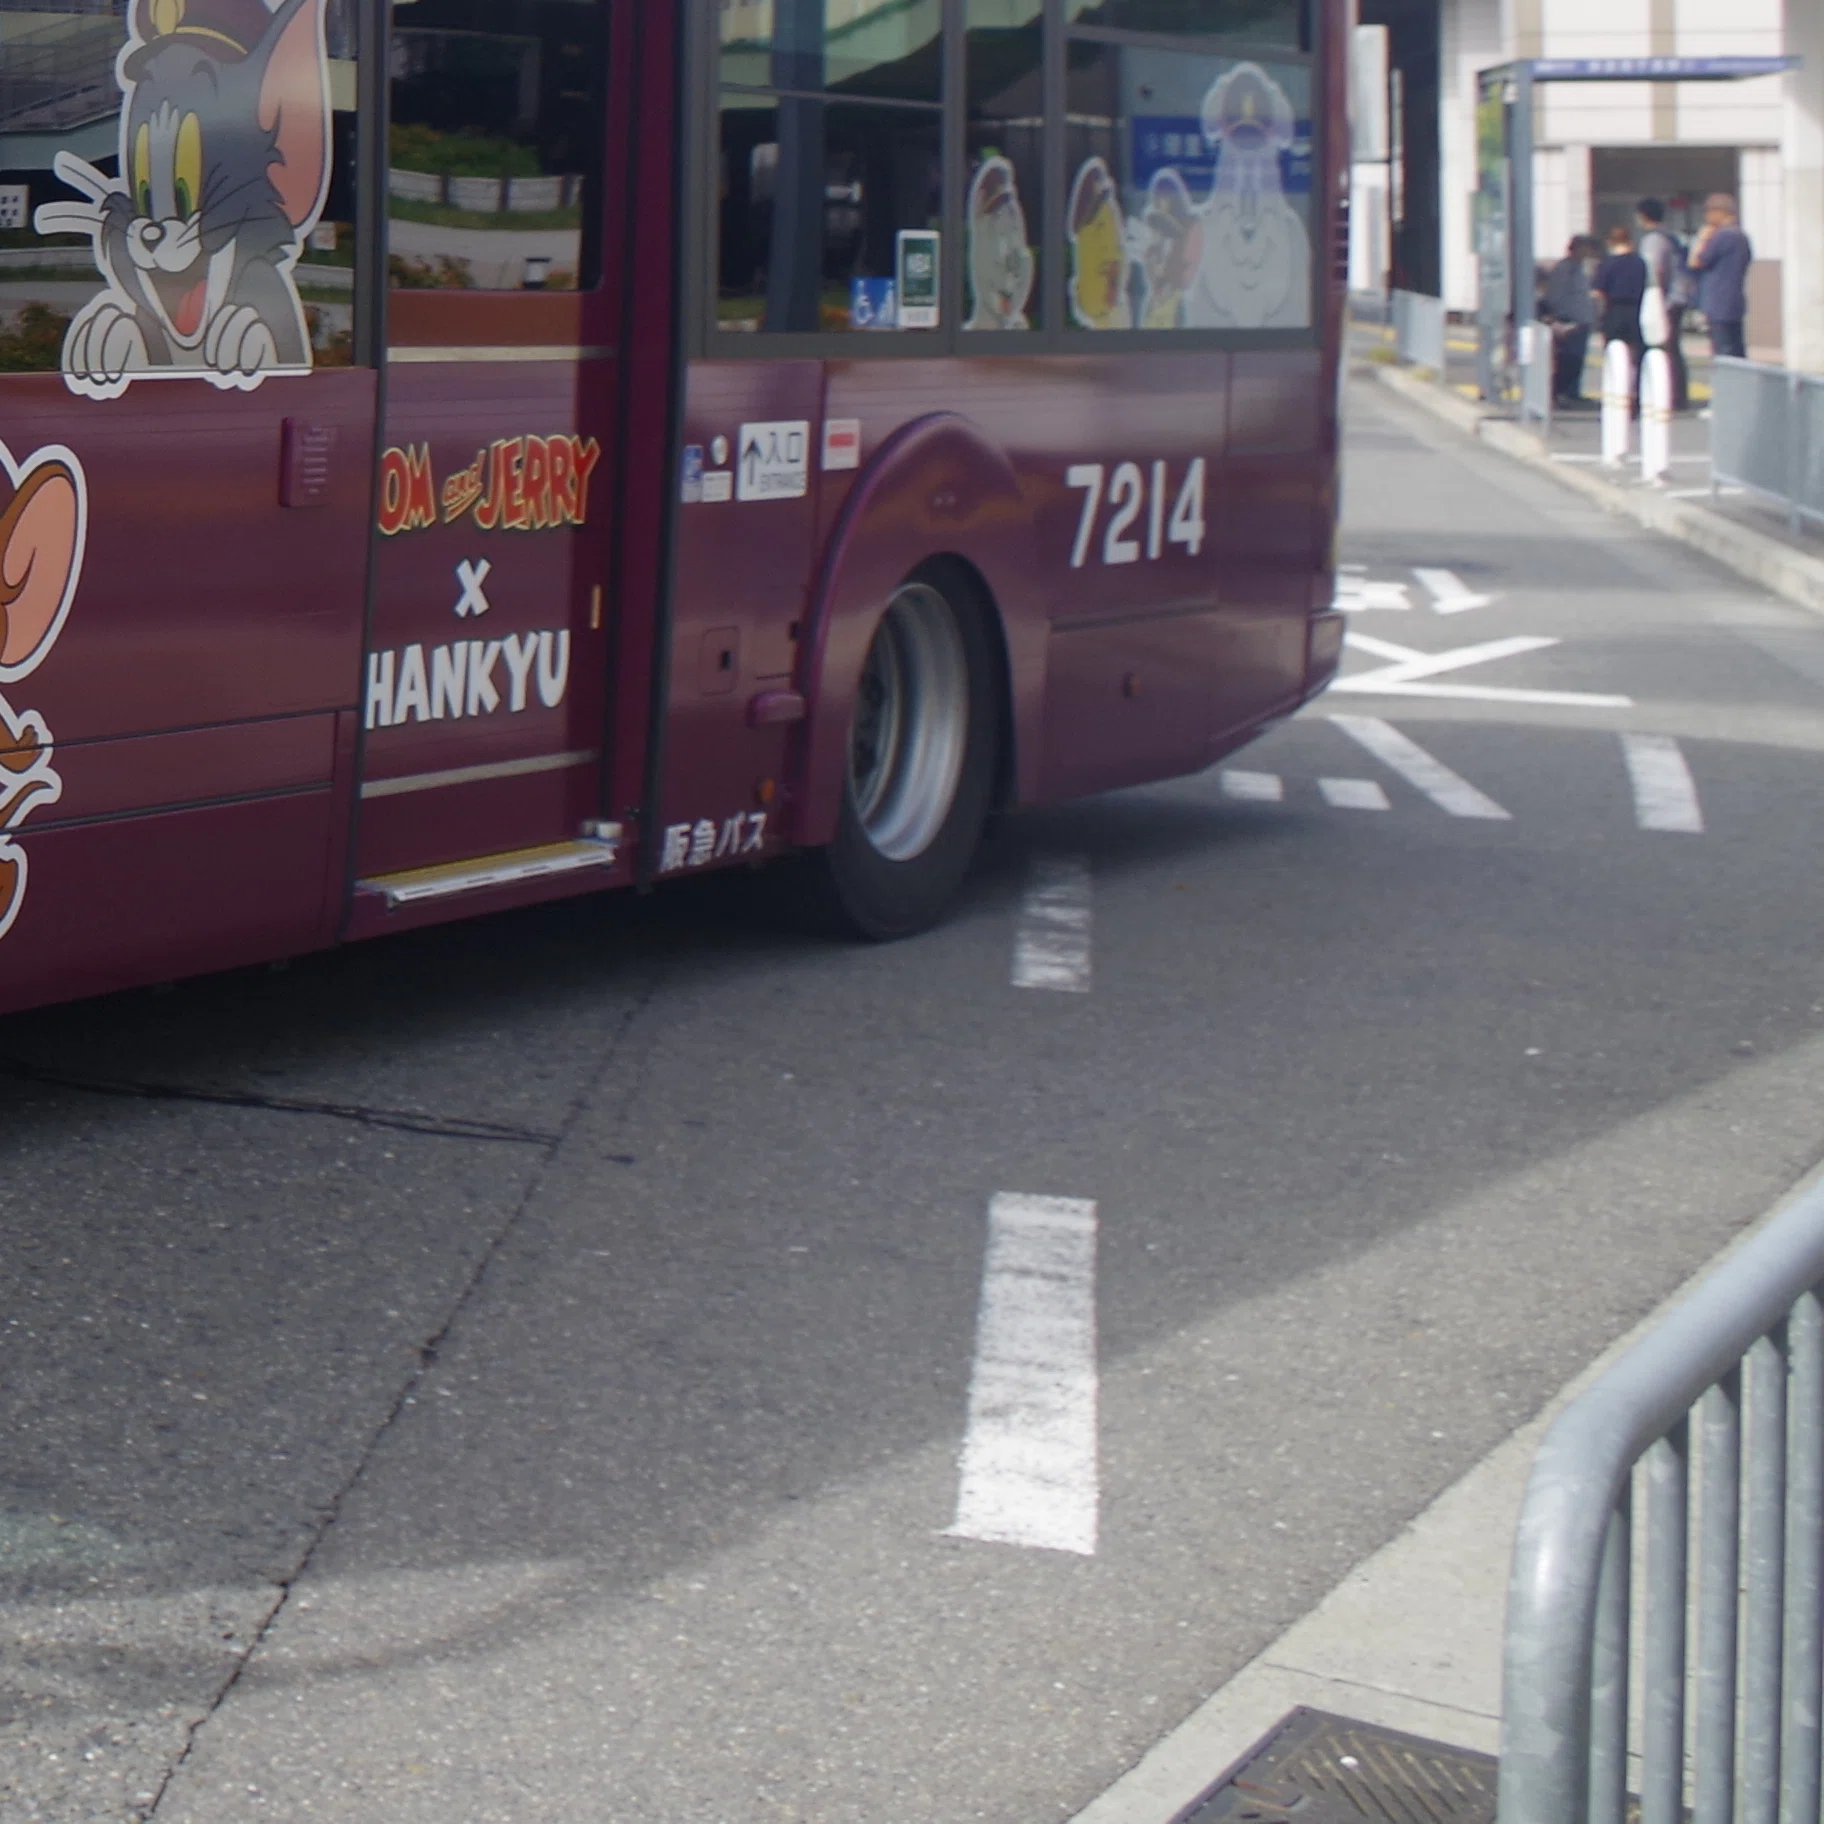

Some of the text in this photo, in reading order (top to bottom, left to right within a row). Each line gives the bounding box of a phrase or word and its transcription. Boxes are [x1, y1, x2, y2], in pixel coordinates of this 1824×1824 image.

[377, 442, 436, 536] OM
[474, 433, 601, 532] JERRY
[765, 431, 802, 465] 入口
[1066, 457, 1206, 568] 7214
[364, 629, 570, 730] HANKYU
[660, 811, 768, 873] 阪急バス
